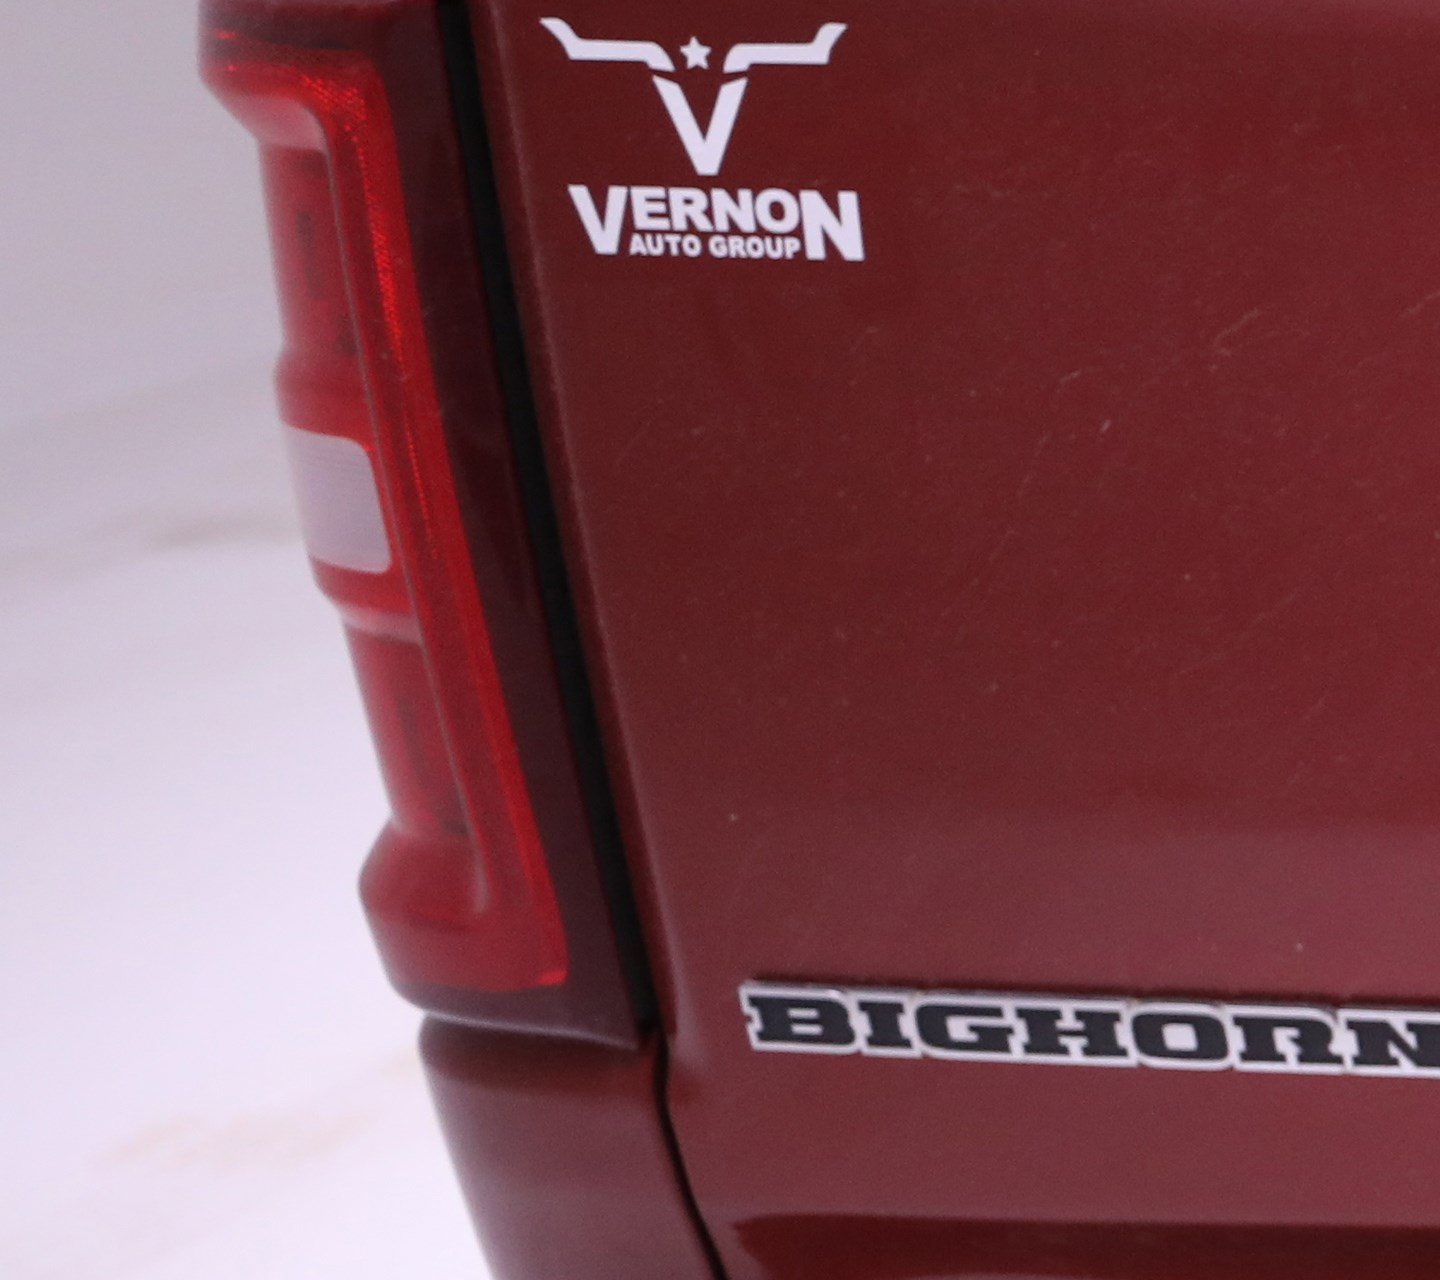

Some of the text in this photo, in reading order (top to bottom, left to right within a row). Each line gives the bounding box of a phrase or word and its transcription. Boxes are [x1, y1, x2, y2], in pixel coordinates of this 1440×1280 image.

[566, 183, 866, 262] VERNON
[629, 233, 801, 259] AUTO GROUP
